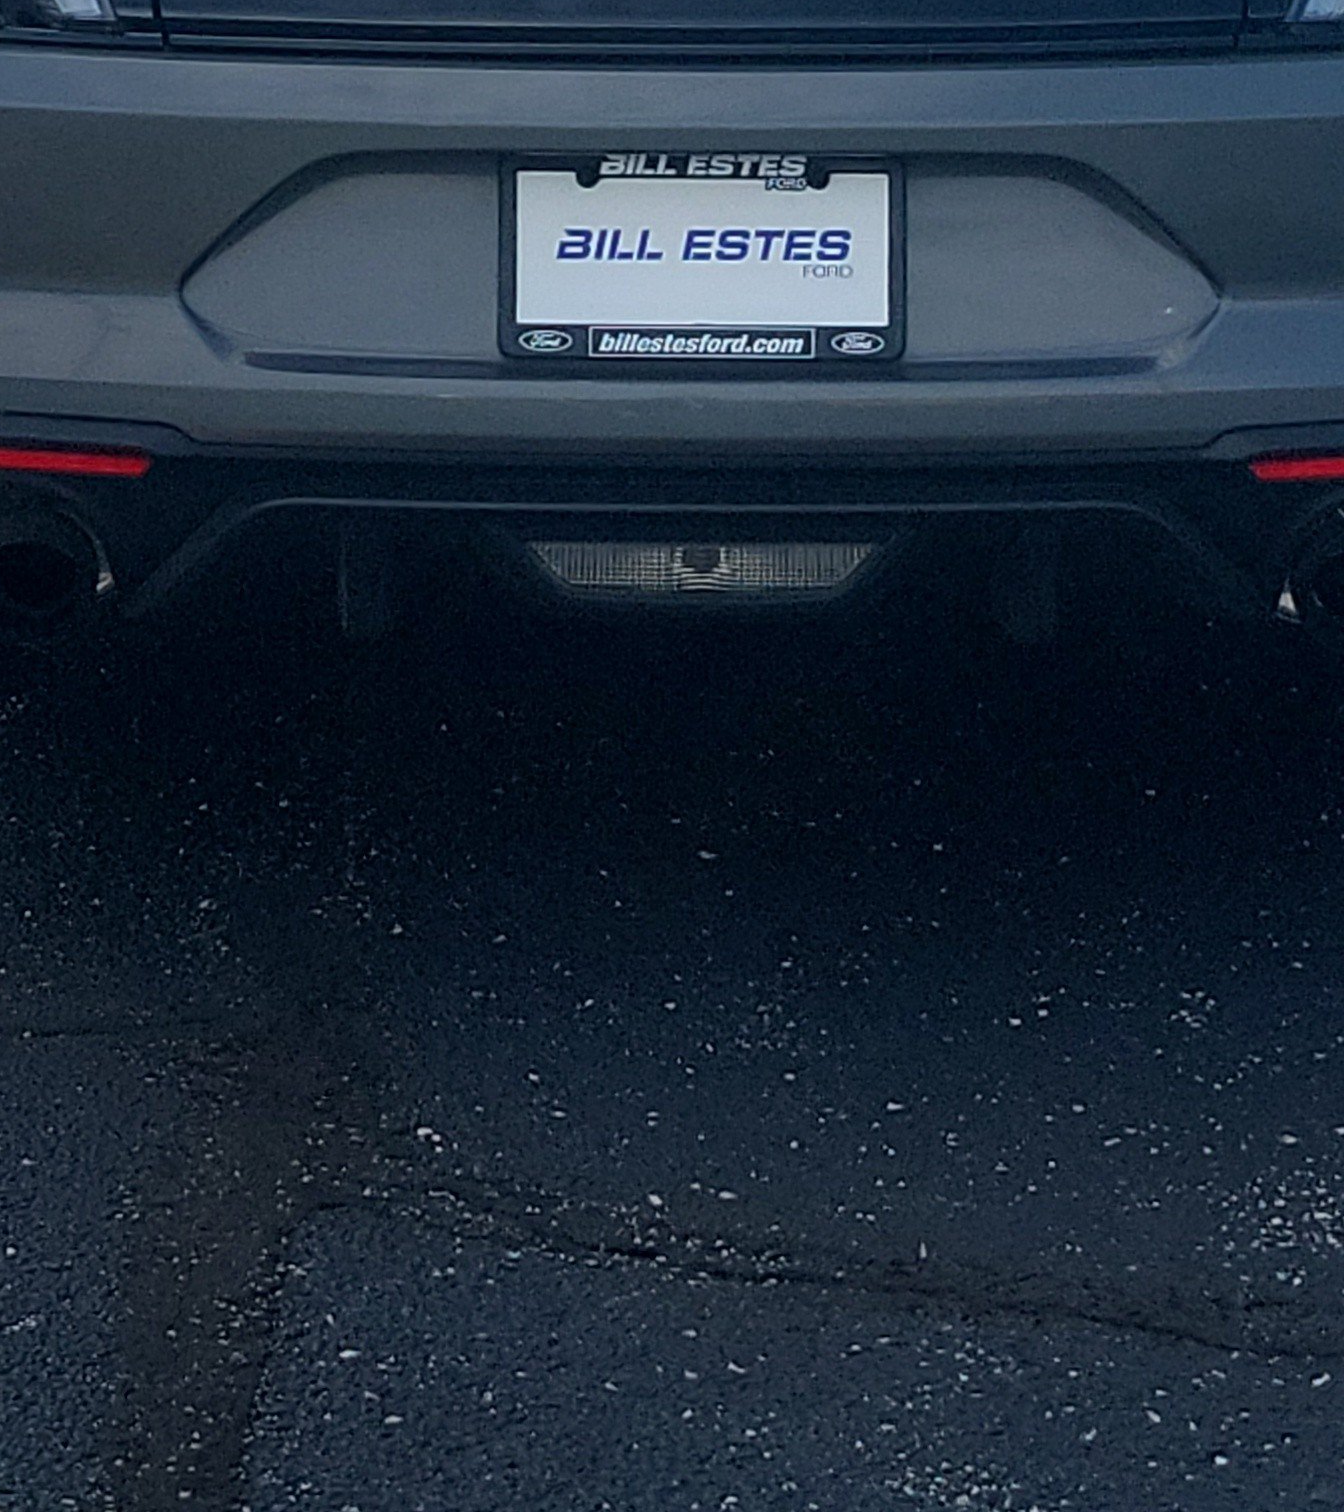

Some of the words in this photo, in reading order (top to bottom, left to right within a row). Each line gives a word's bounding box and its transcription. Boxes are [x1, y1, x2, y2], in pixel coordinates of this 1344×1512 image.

[599, 154, 677, 175] BILL
[687, 154, 807, 177] ESTES
[556, 229, 663, 260] BILL
[682, 229, 852, 261] ESTES
[802, 264, 854, 279] FORD
[598, 332, 804, 354] billestesford.com
